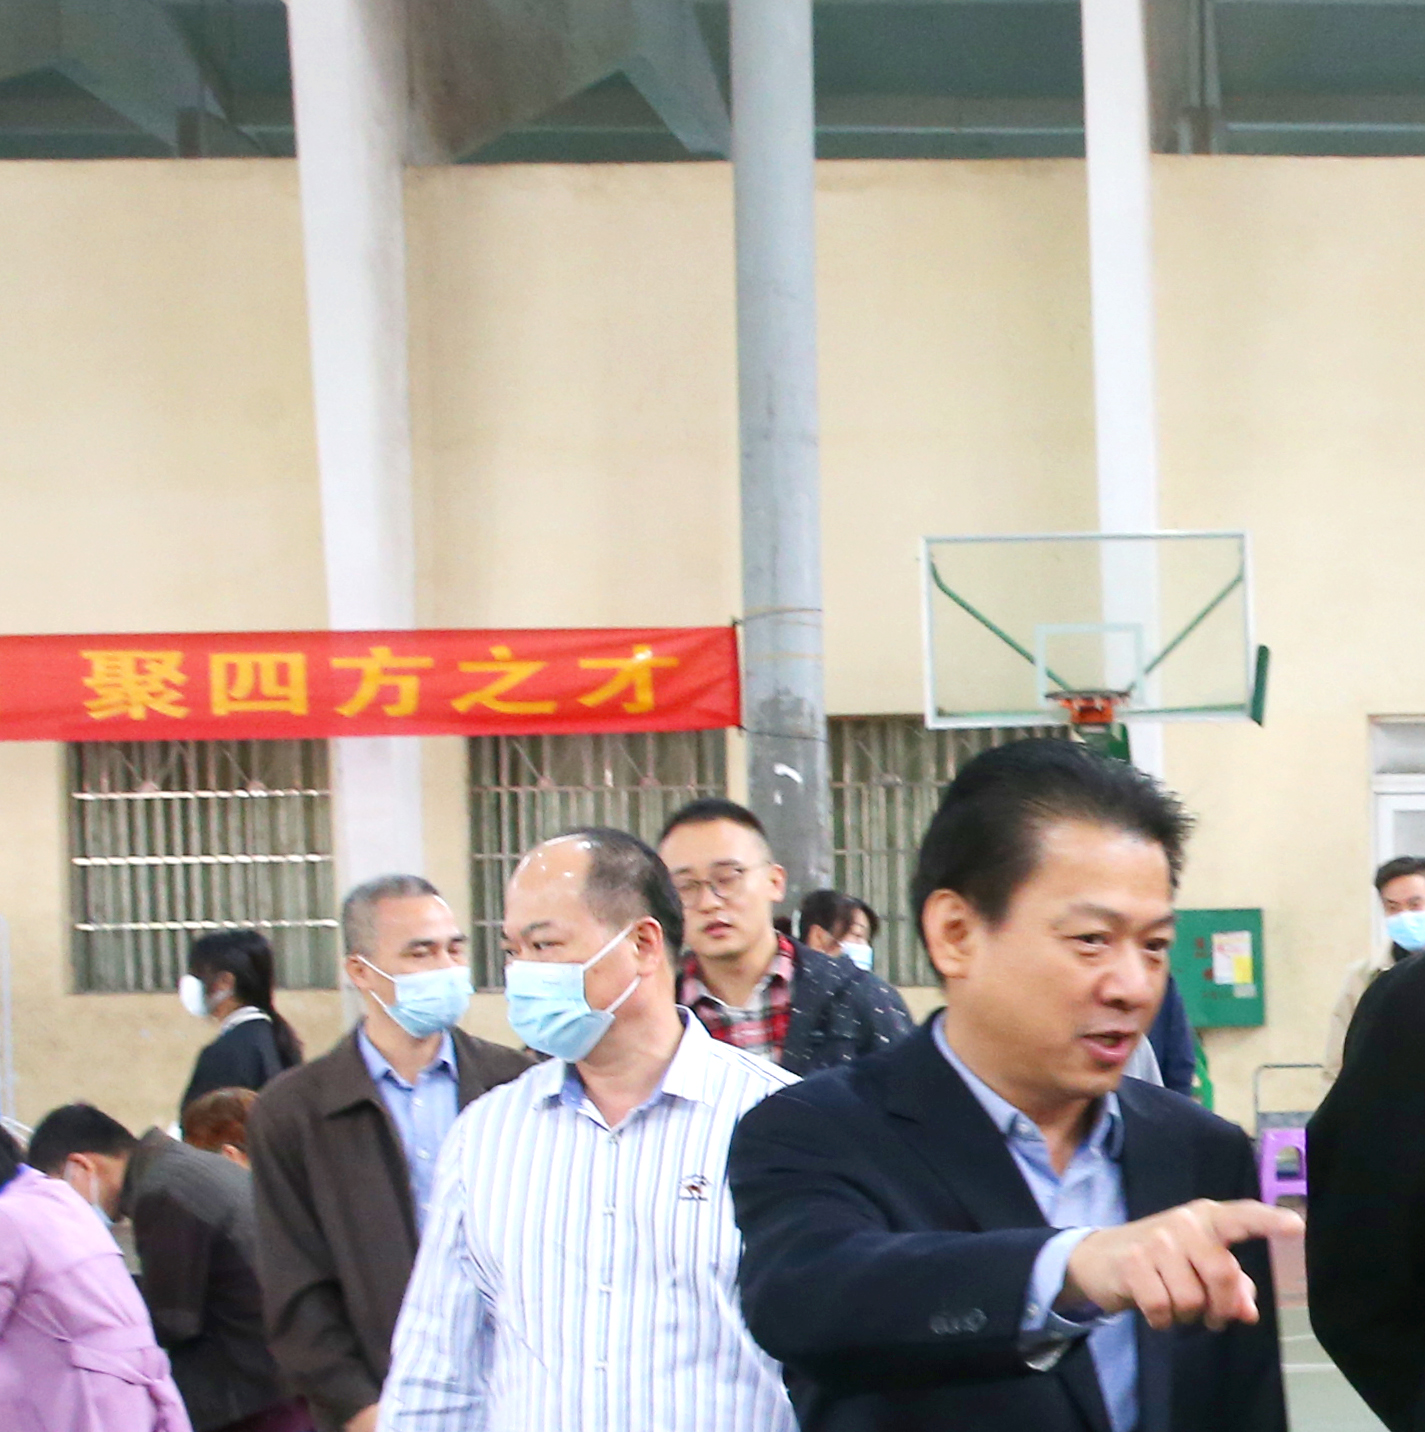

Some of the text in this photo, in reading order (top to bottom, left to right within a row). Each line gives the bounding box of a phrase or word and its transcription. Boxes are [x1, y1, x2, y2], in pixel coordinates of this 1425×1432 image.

[80, 646, 679, 721] 聚四方之才
